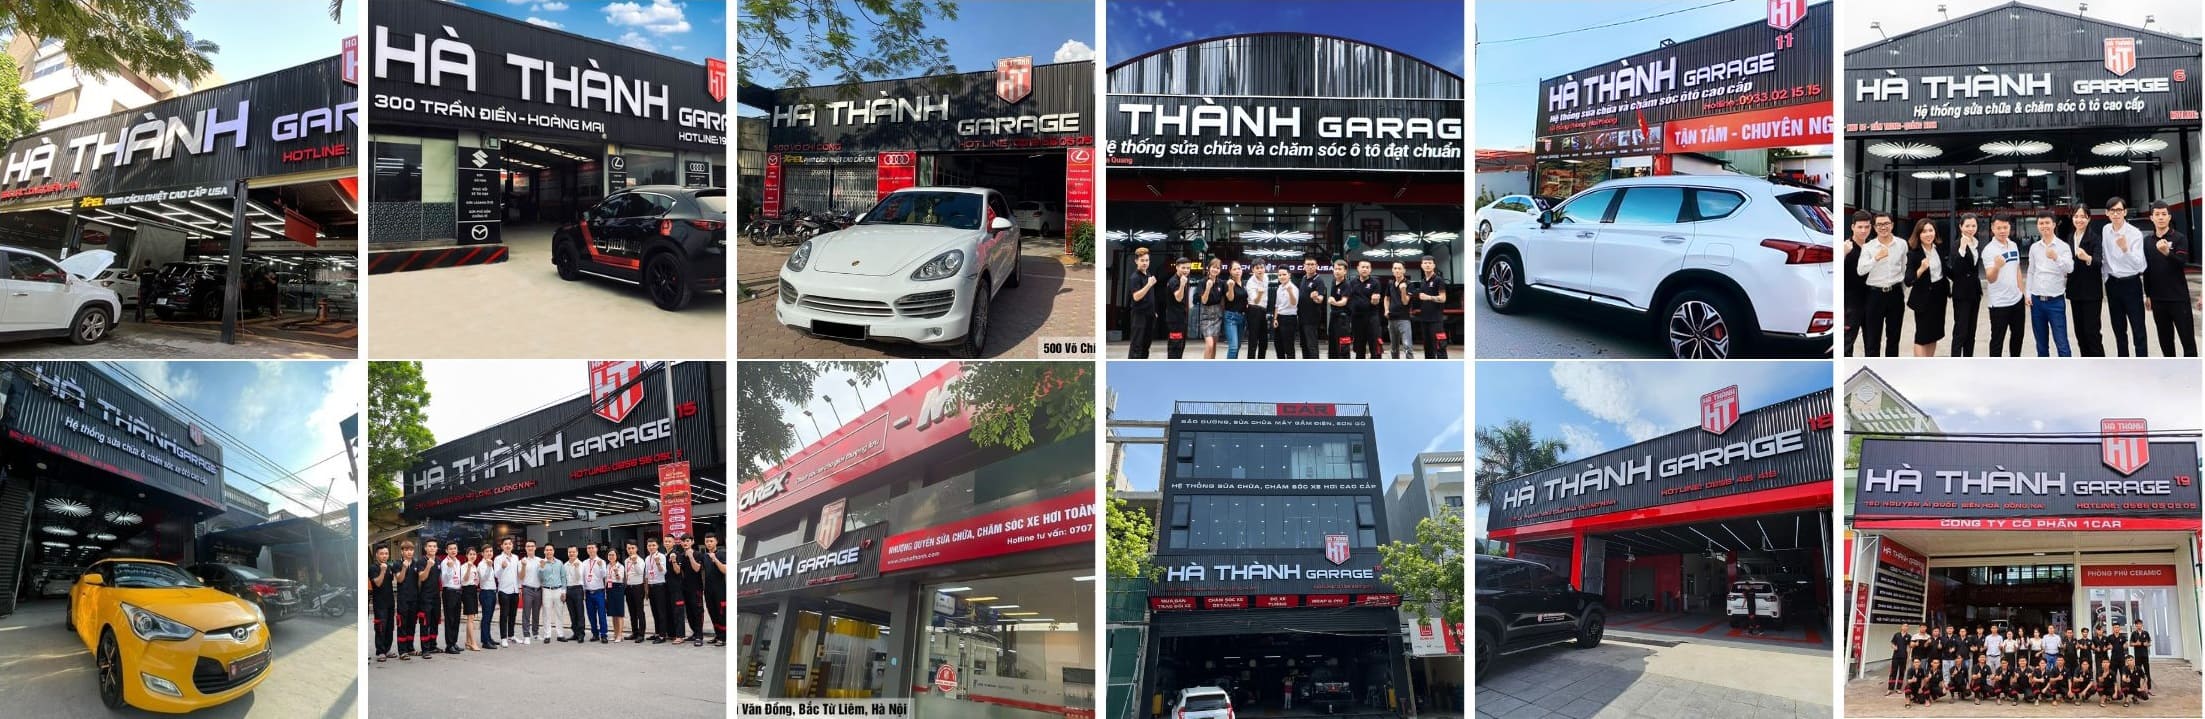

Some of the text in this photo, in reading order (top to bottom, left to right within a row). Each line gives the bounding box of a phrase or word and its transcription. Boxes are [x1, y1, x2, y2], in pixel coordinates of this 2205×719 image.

[1775, 32, 1794, 50] 11
[375, 25, 669, 121] HÀ THÀNH
[1549, 52, 1775, 112] HÀ THÀNH GARAGE
[1856, 66, 2170, 102] HÀ THÀNH GARAGE
[2173, 69, 2187, 83] 6
[826, 90, 949, 126] THÀNH
[1618, 101, 1629, 112] và
[1659, 94, 1679, 106] sóc
[1701, 85, 1725, 98] cao
[1726, 77, 1753, 96] cấp
[1914, 96, 2145, 119] Hệ thống sửa chữa & chăm sóc ô tô cao cấp
[374, 94, 415, 111] 300
[420, 99, 475, 118] TRẦN
[527, 113, 579, 130] HOÀNG
[582, 119, 605, 133] MAI
[957, 112, 1080, 136] GARAGE
[1119, 97, 1462, 140] THÀNH GARAG
[3, 137, 58, 185] HÀ
[69, 100, 250, 173] THÀNH
[1674, 129, 1697, 148] TẬN
[1700, 124, 1728, 143] TÂM
[1741, 116, 1807, 141] CHUYÊN
[1808, 116, 1834, 135] NG
[283, 144, 350, 162] HOTLINE:
[1121, 138, 1461, 161] thống sửa chữa và chăm sóc ô tô đạt chuẩn
[168, 190, 188, 200] CAO
[208, 187, 228, 196] USA
[675, 401, 698, 420] 15
[1282, 404, 1328, 415] CAR
[65, 416, 79, 431] Hệ
[80, 423, 105, 444] thống
[140, 449, 146, 458] &
[176, 446, 217, 475] GARAGE
[413, 460, 446, 494] HÀ
[452, 430, 564, 486] THÀNH
[570, 417, 671, 459] GARAGE
[1502, 428, 1804, 510] HÀ THÀNH GARAGE
[1171, 483, 1183, 491] HỆ
[1185, 481, 1215, 489] THỐNG
[1865, 462, 2192, 495] HÀ THÀNH GARAGE 19
[977, 525, 1002, 539] CHĂM
[1004, 516, 1024, 532] SÓC
[1027, 514, 1040, 527] XE
[1043, 511, 1061, 525] HƠI
[1064, 503, 1095, 520] TOÀN
[1007, 524, 1093, 545] Hotline tư vấn: 0707
[1987, 519, 2007, 528] TY
[2083, 520, 2122, 528] 1CAR
[739, 554, 795, 586] THÀNH
[796, 547, 860, 574] GARAGE
[1167, 561, 1374, 582] HÀ THÀNH GARAGE
